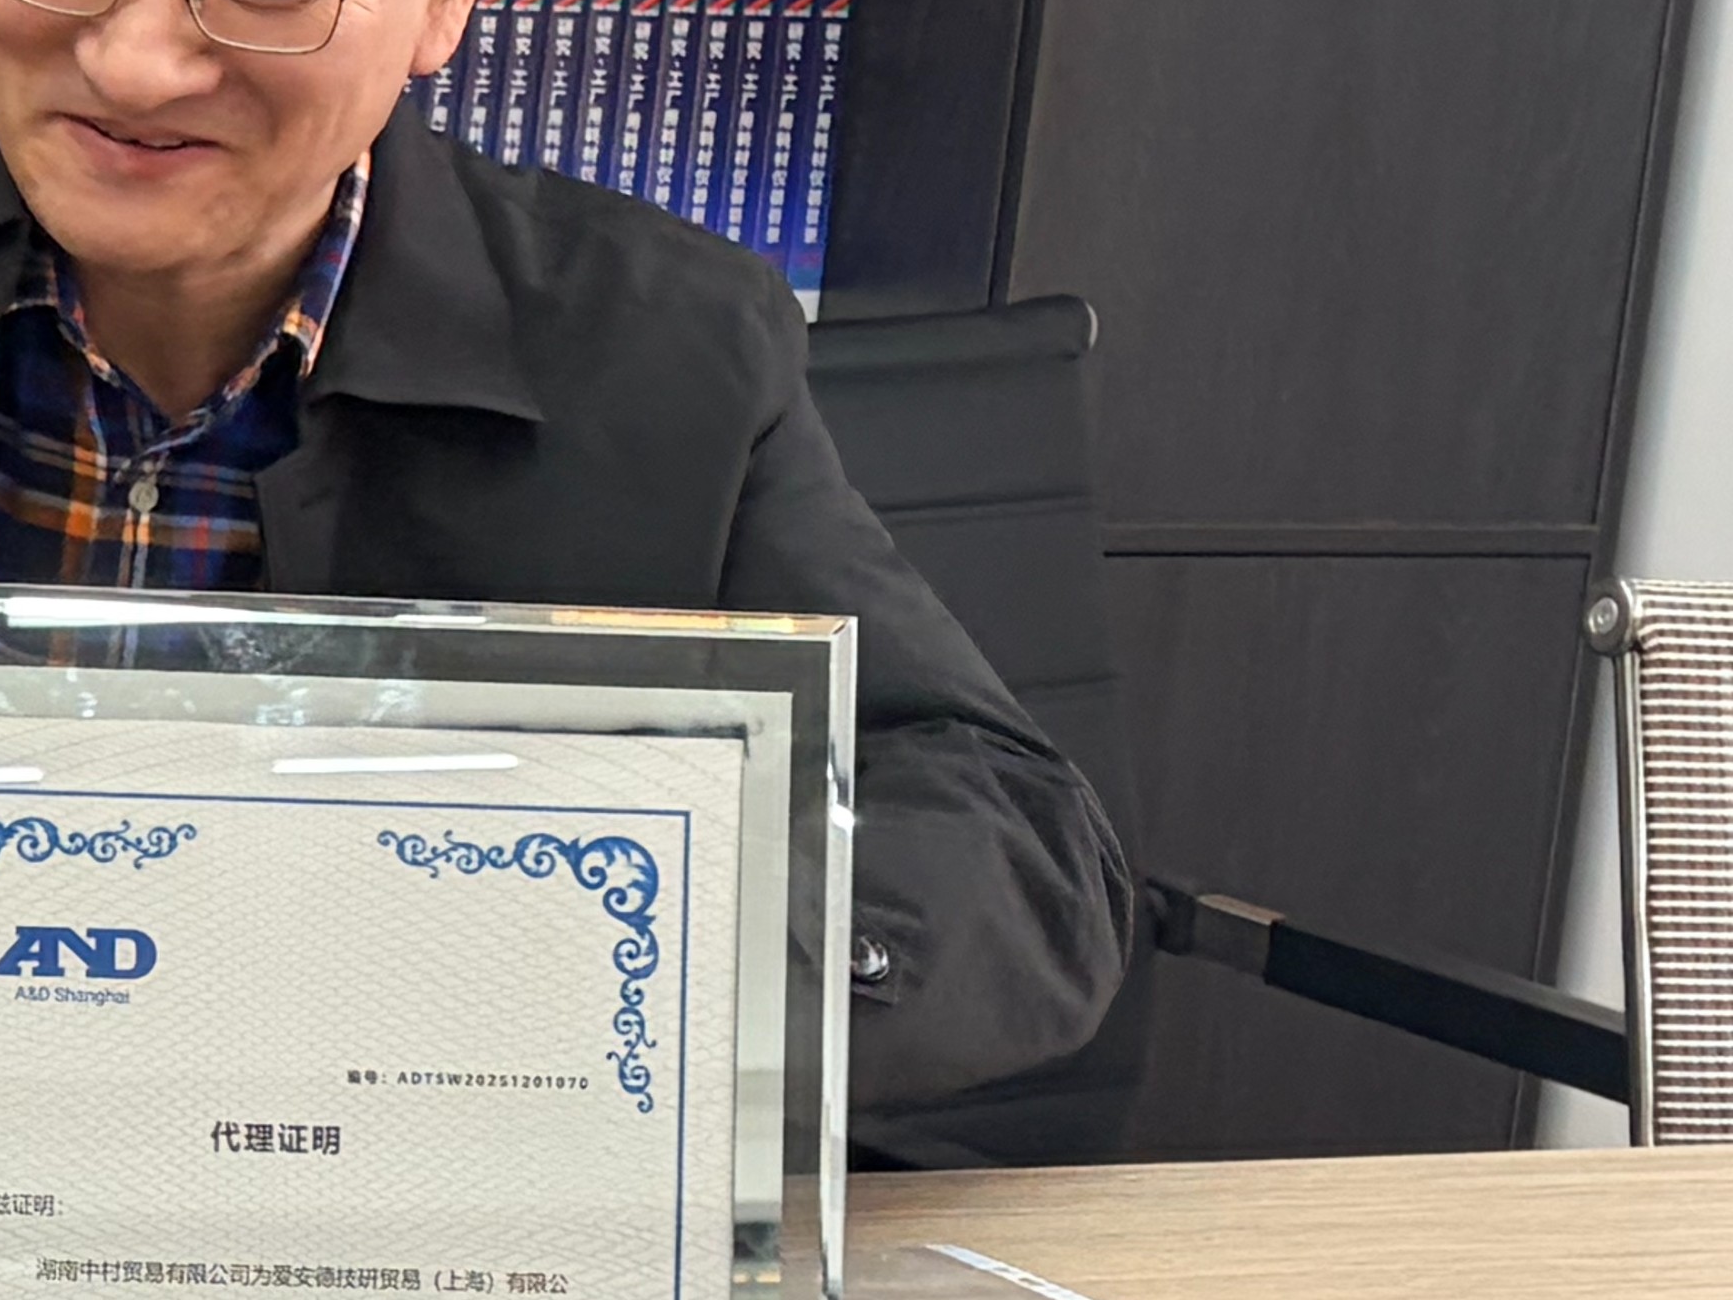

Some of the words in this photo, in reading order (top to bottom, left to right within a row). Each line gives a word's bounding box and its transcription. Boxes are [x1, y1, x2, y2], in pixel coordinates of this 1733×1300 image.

[15, 986, 50, 1001] A&D
[55, 986, 130, 1006] Shanghai
[211, 1121, 341, 1156] 代理证明
